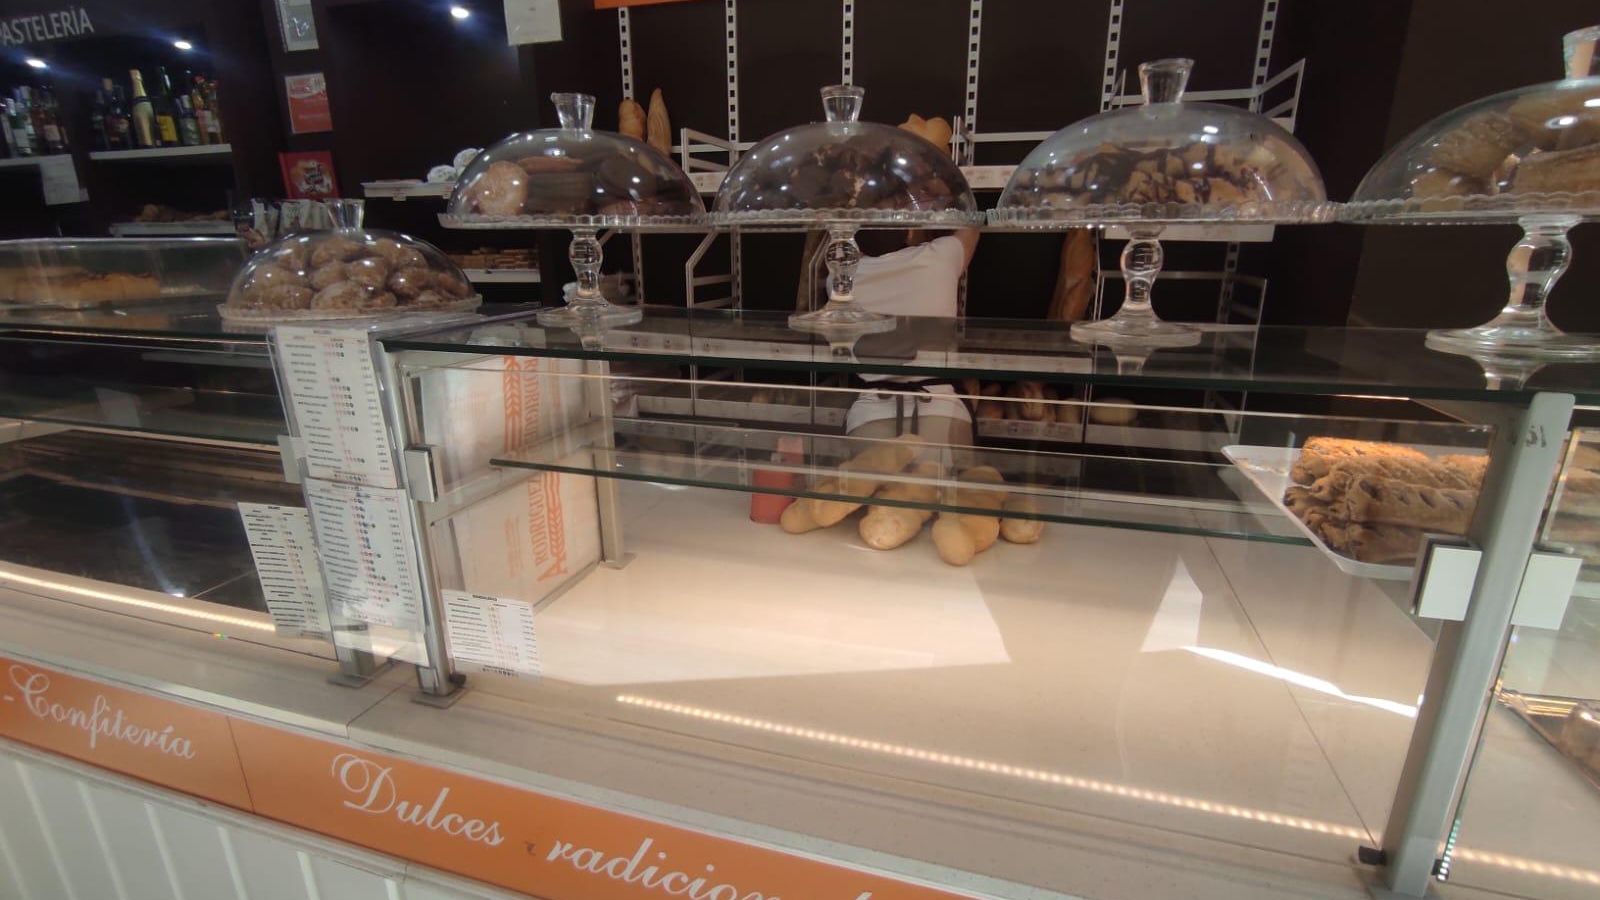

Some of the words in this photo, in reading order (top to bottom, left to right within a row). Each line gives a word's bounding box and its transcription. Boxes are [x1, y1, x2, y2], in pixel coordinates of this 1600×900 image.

[0, 6, 95, 46] ASTELERÍA
[8, 664, 196, 760] Confitería
[331, 753, 505, 846] Dulces
